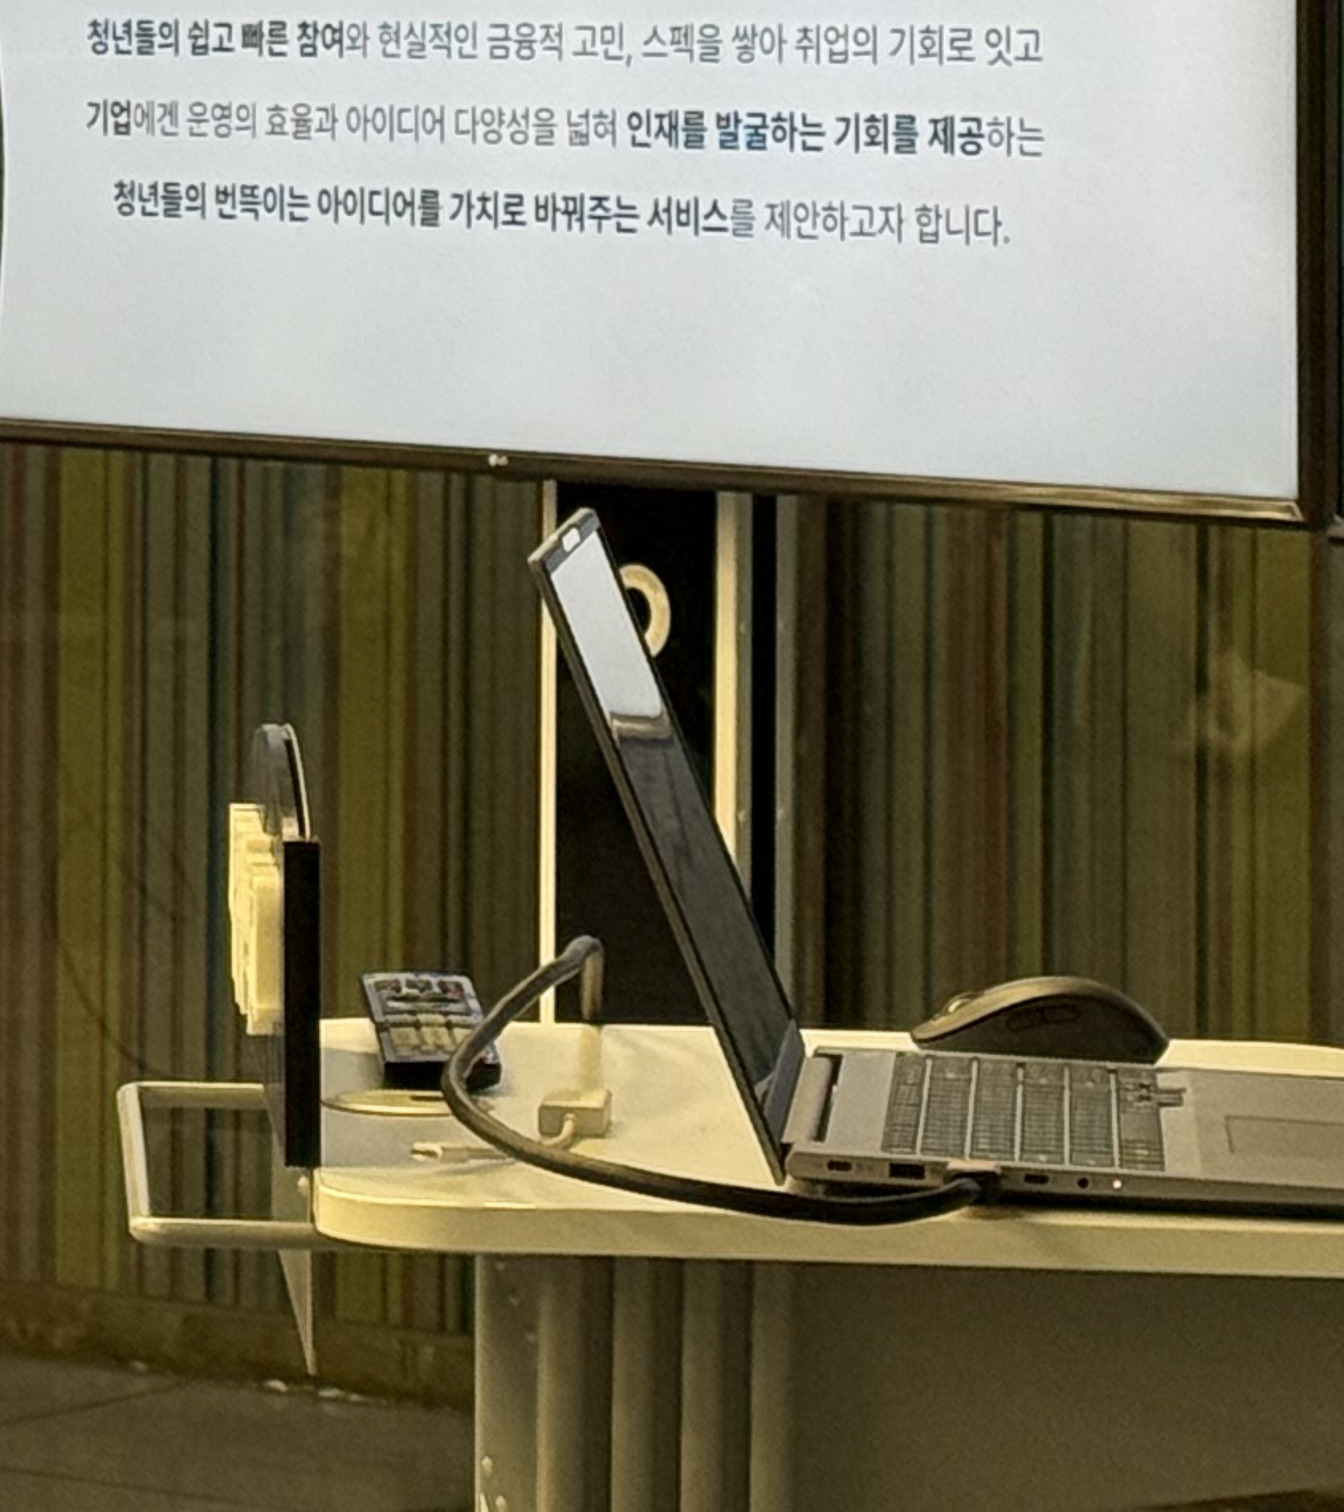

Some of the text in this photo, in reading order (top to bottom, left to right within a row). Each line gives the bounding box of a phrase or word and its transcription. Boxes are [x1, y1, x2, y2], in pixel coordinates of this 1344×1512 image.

[87, 18, 1044, 68] 청년들의 쉽고 빠른 참여와 현실적인 금융적 고민, 스펙을 쌓아 취업의 기회로 잇고
[86, 99, 1044, 157] 기업에겐 운영의 효율과 아이디어 다양성을 넓혀 인재를 발굴하는 기회를 제공하는
[113, 179, 1011, 247] 청년들의 번뜩이는 아이디어를 가치로 바꿔주는 서비스를 제안하고자 합니다.
